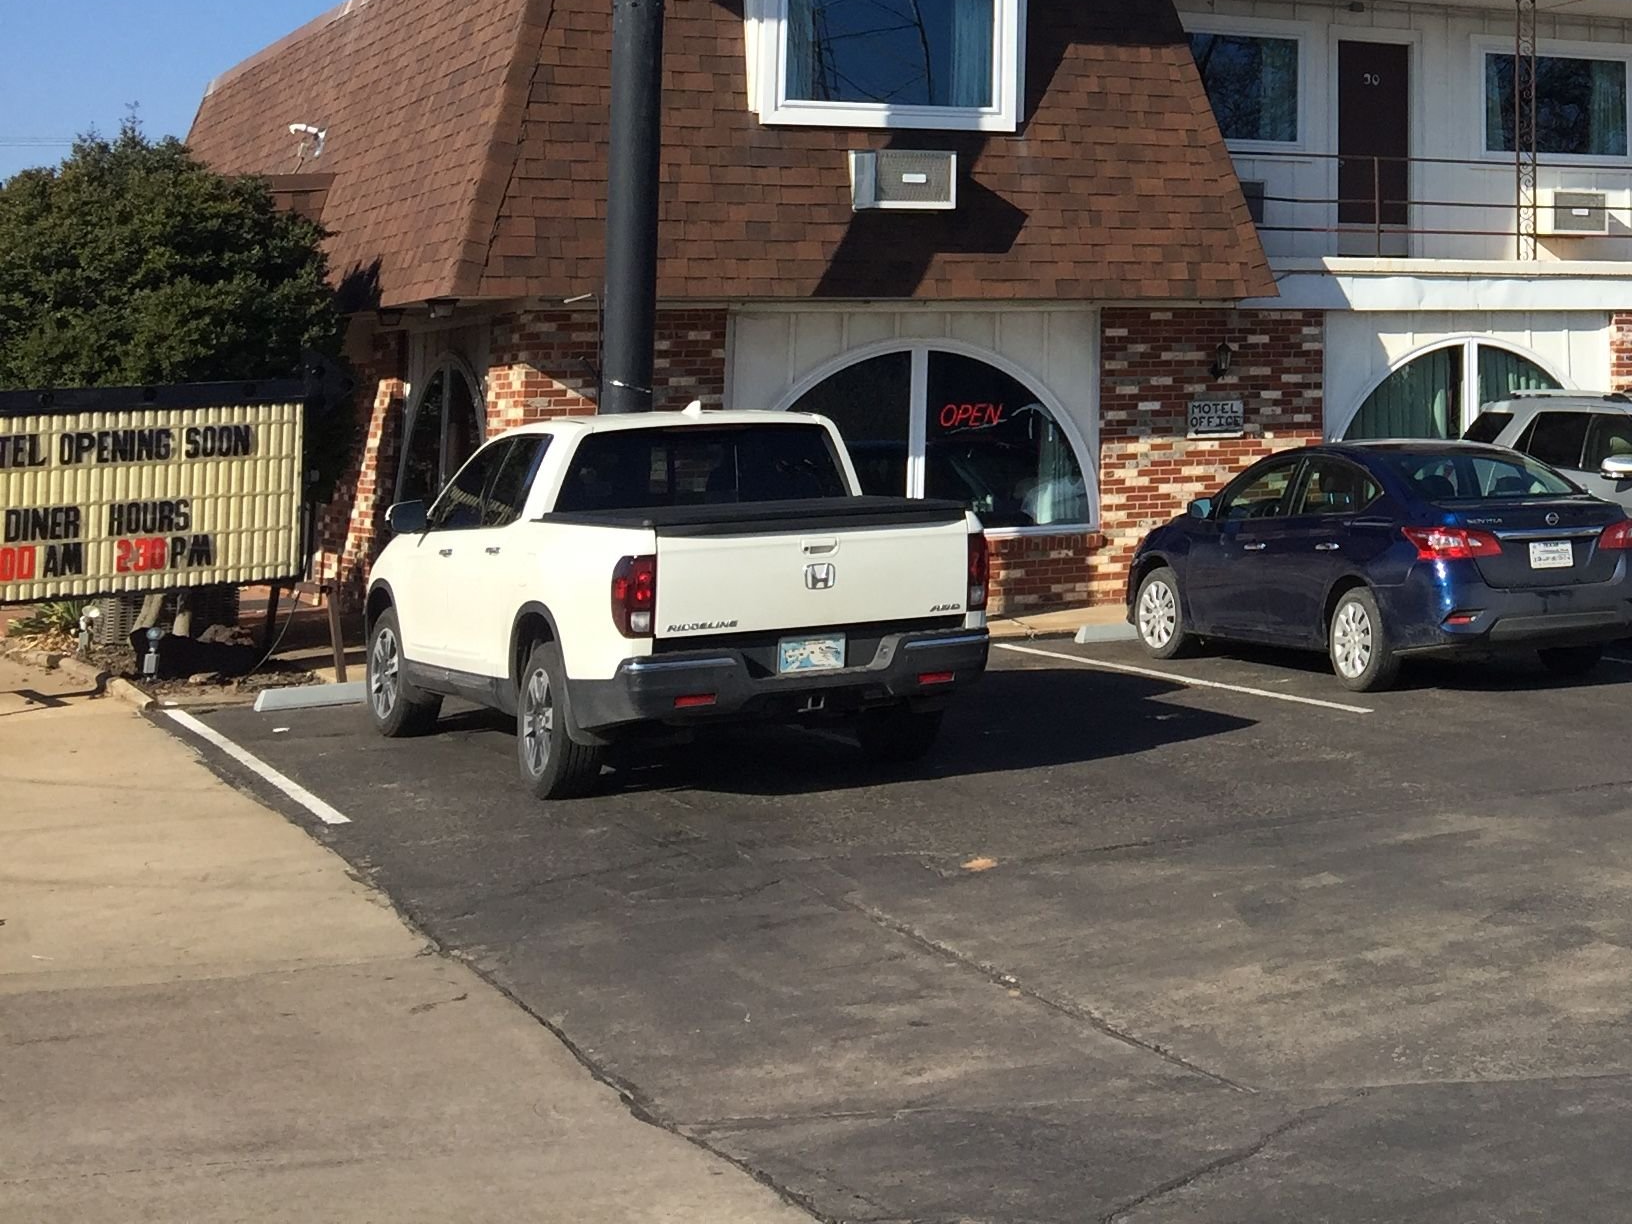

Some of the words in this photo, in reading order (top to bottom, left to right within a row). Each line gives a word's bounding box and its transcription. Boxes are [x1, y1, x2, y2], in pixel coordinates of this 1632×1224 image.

[1363, 73, 1381, 86] 30
[940, 403, 1004, 427] OPEN
[1191, 403, 1239, 415] MOTEL
[1190, 416, 1241, 428] OFFICE
[59, 428, 173, 465] OPENING
[185, 425, 251, 459] SOON
[4, 506, 81, 543] DINER
[108, 499, 190, 536] HOURS
[43, 542, 83, 577] AM
[666, 619, 739, 633] RIDGELINE
